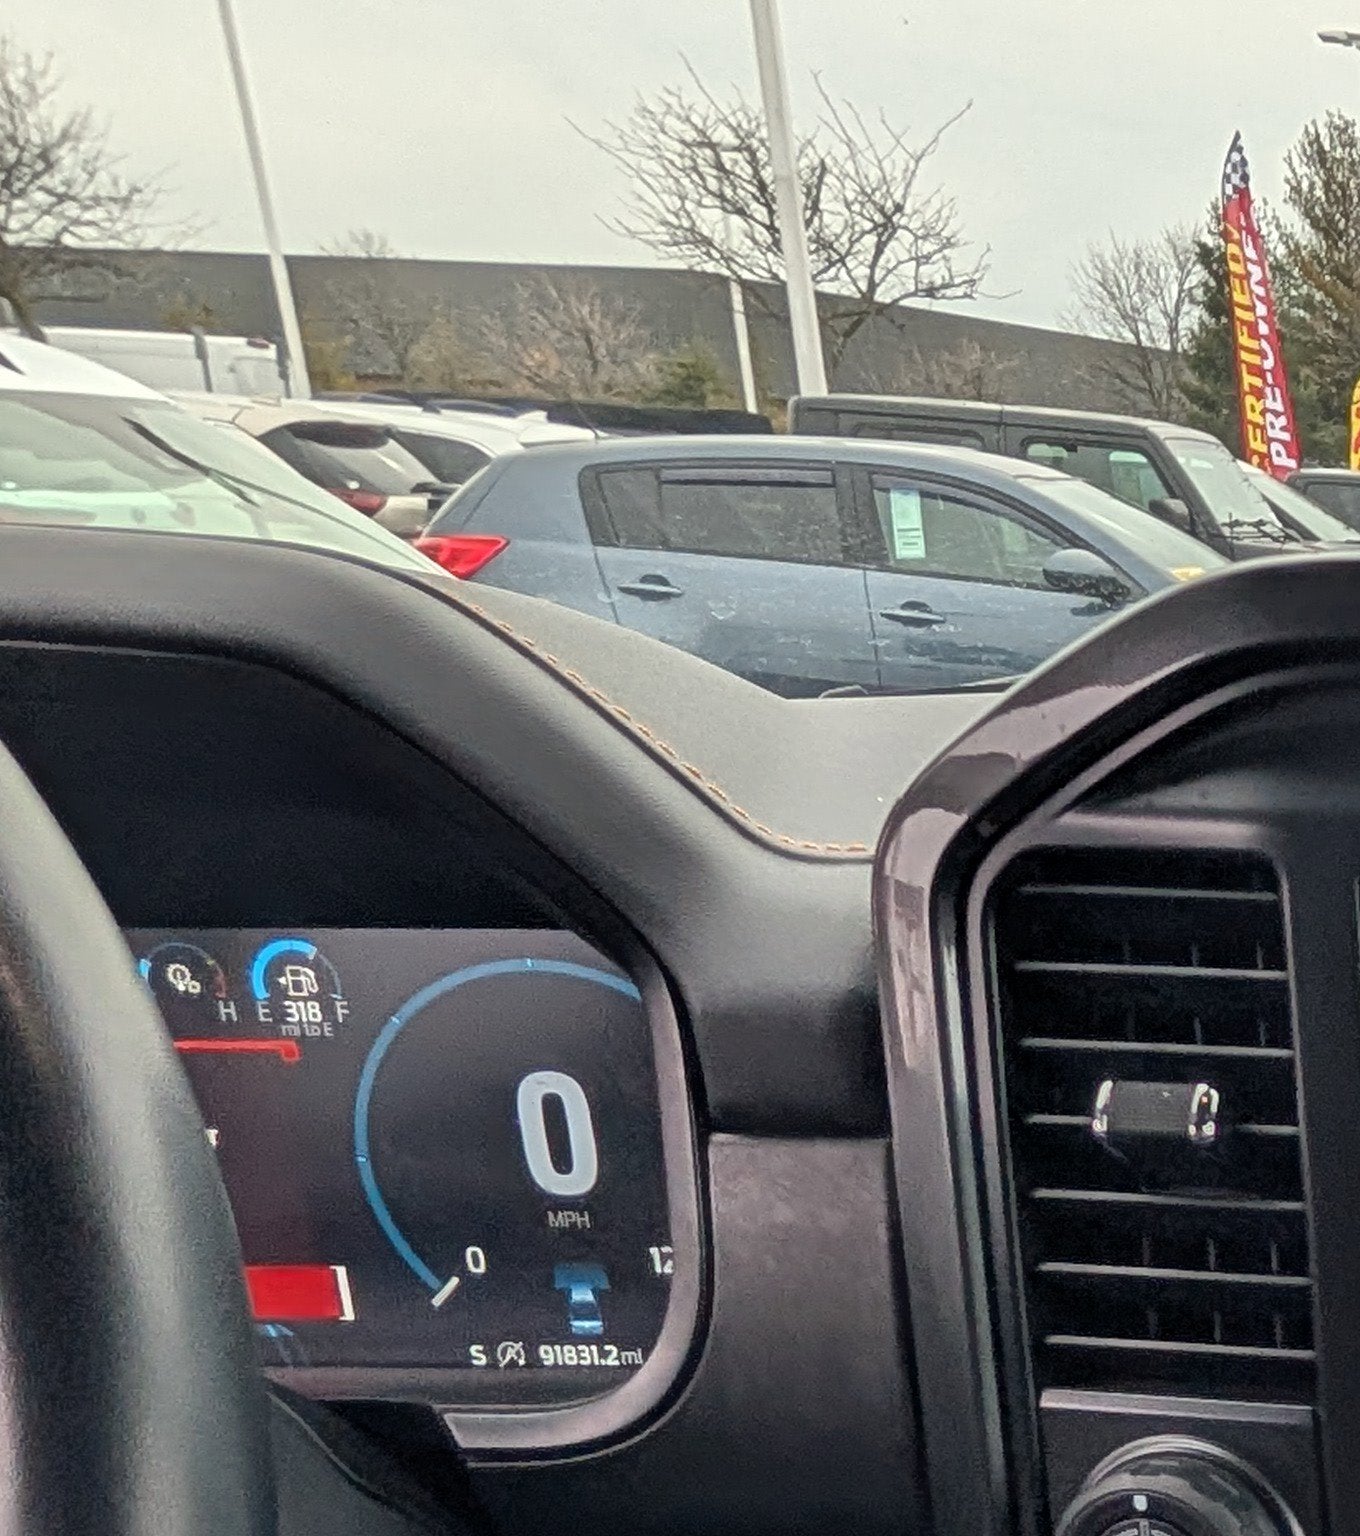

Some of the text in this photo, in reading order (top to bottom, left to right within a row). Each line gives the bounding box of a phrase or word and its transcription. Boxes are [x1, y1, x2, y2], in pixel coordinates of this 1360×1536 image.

[219, 1002, 238, 1022] H
[258, 1002, 272, 1022] E
[283, 1000, 323, 1022] 318
[336, 1002, 350, 1022] F
[515, 1069, 599, 1197] 0
[546, 1210, 592, 1230] MPH
[464, 1246, 487, 1275] 0
[469, 1345, 487, 1367] S
